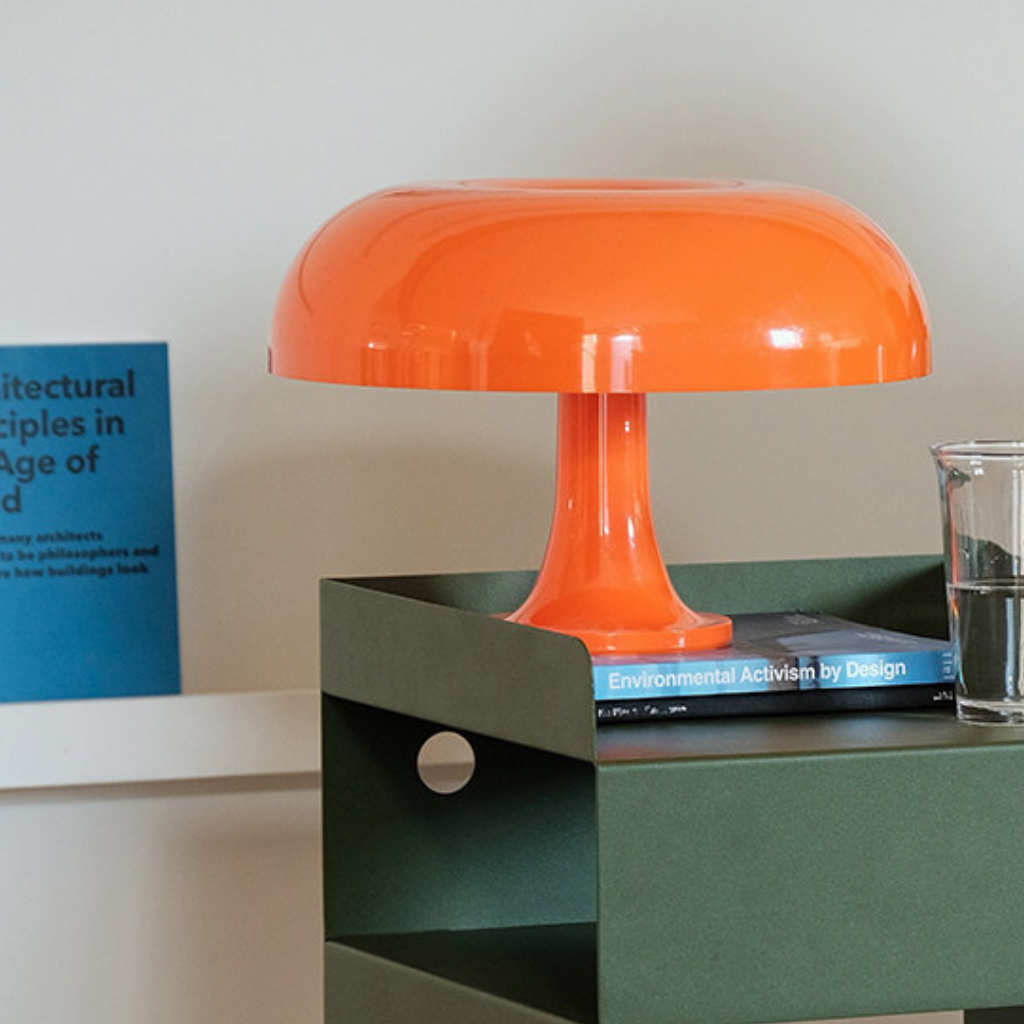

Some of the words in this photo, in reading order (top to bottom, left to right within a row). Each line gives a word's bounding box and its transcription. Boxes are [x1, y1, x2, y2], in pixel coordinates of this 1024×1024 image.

[95, 407, 125, 436] in
[0, 449, 56, 483] Age
[66, 444, 100, 474] of
[608, 667, 736, 690] Environmental
[740, 663, 816, 684] Activism
[820, 662, 842, 684] by
[846, 660, 907, 681] Design
